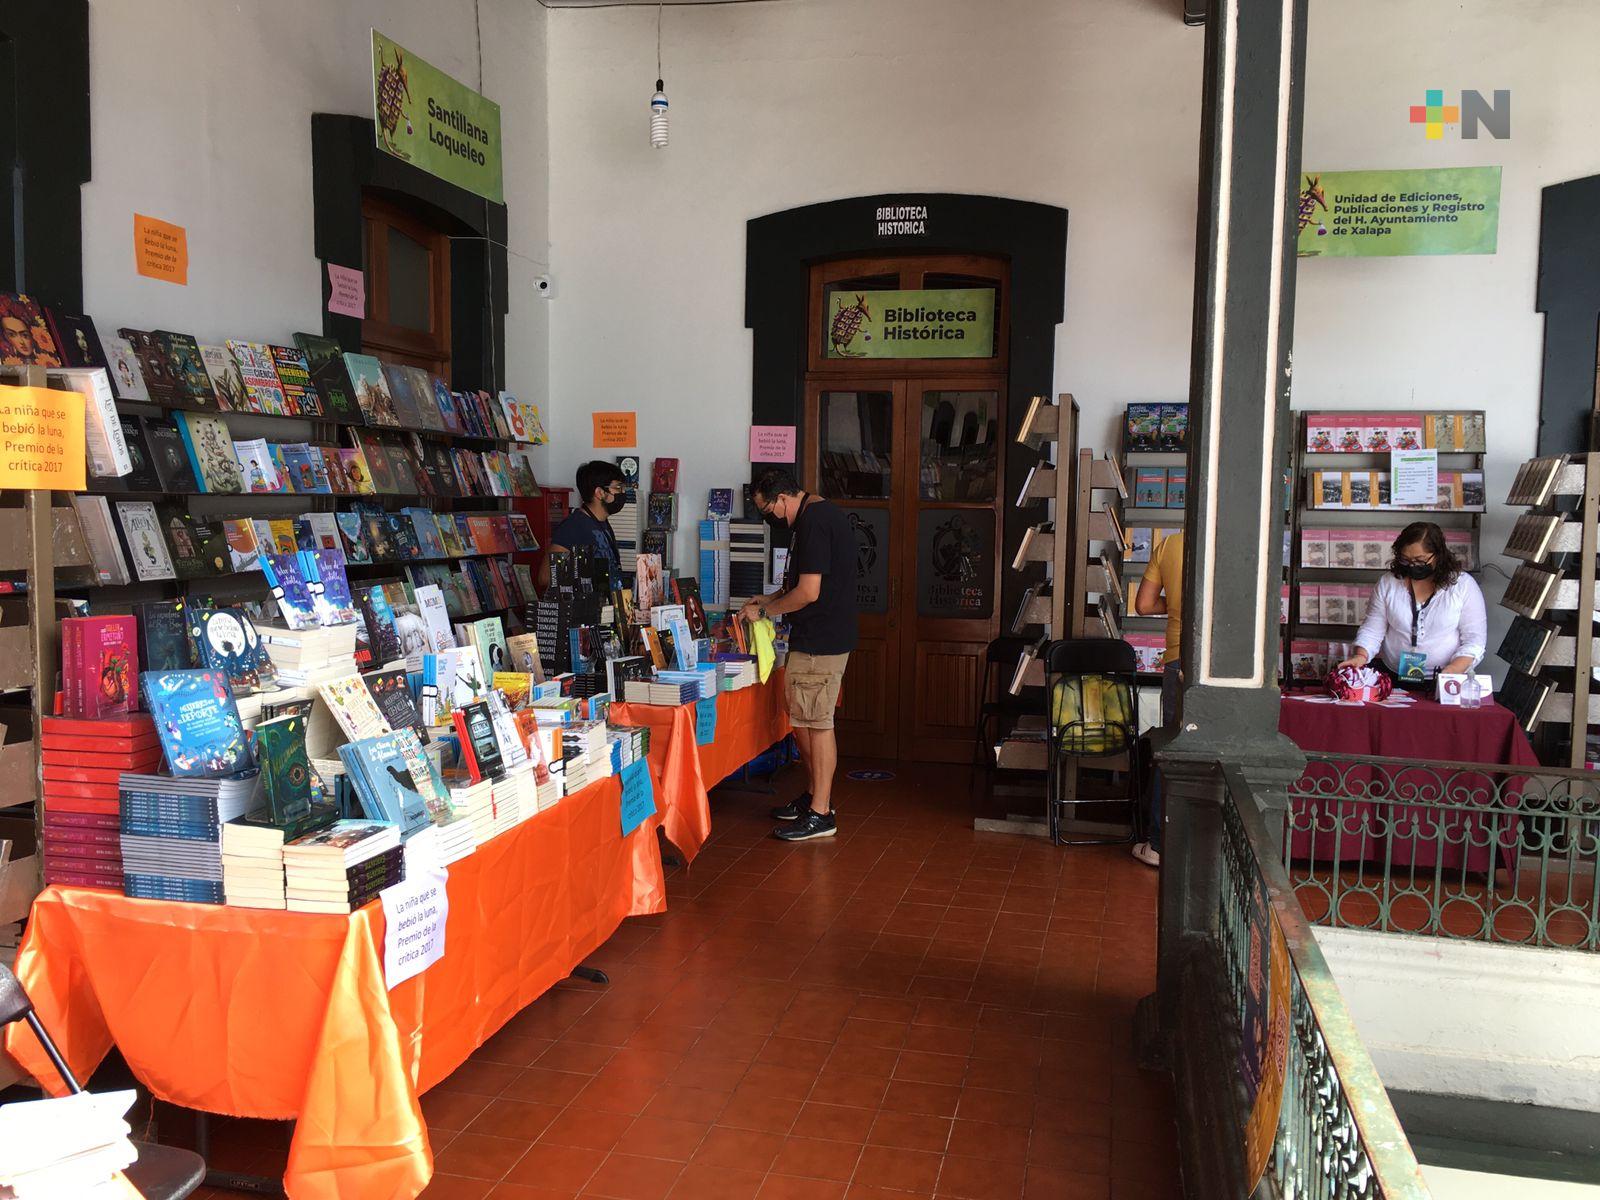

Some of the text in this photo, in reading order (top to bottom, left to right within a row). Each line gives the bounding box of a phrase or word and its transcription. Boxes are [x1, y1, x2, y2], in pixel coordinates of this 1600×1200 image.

[428, 97, 488, 145] Santillana
[429, 122, 485, 167] Loqueleo
[1334, 192, 1463, 204] Unidad de Ediciones,
[876, 206, 928, 220] BIBLIOTECA
[1334, 202, 1485, 214] Publicaciones y Registro
[1333, 213, 1458, 226] del H. Ayuntamiento
[878, 221, 925, 235] HISTORICA
[1332, 226, 1392, 237] de Xalapa
[884, 307, 976, 323] Biblioteca
[884, 325, 965, 340] Histórica
[14, 404, 40, 416] niña
[42, 409, 56, 420] que
[56, 410, 66, 420] se
[2, 422, 36, 434] bebió
[38, 424, 46, 436] la
[104, 398, 125, 456] LEY DE LOBOS
[5, 441, 64, 455] Premio de la
[8, 460, 63, 472] crítica 2017
[396, 886, 437, 914] La niña que se
[398, 914, 417, 932] bebió
[417, 912, 424, 922] la
[398, 922, 437, 949] Premio de la
[398, 938, 434, 966] crítica 2017
